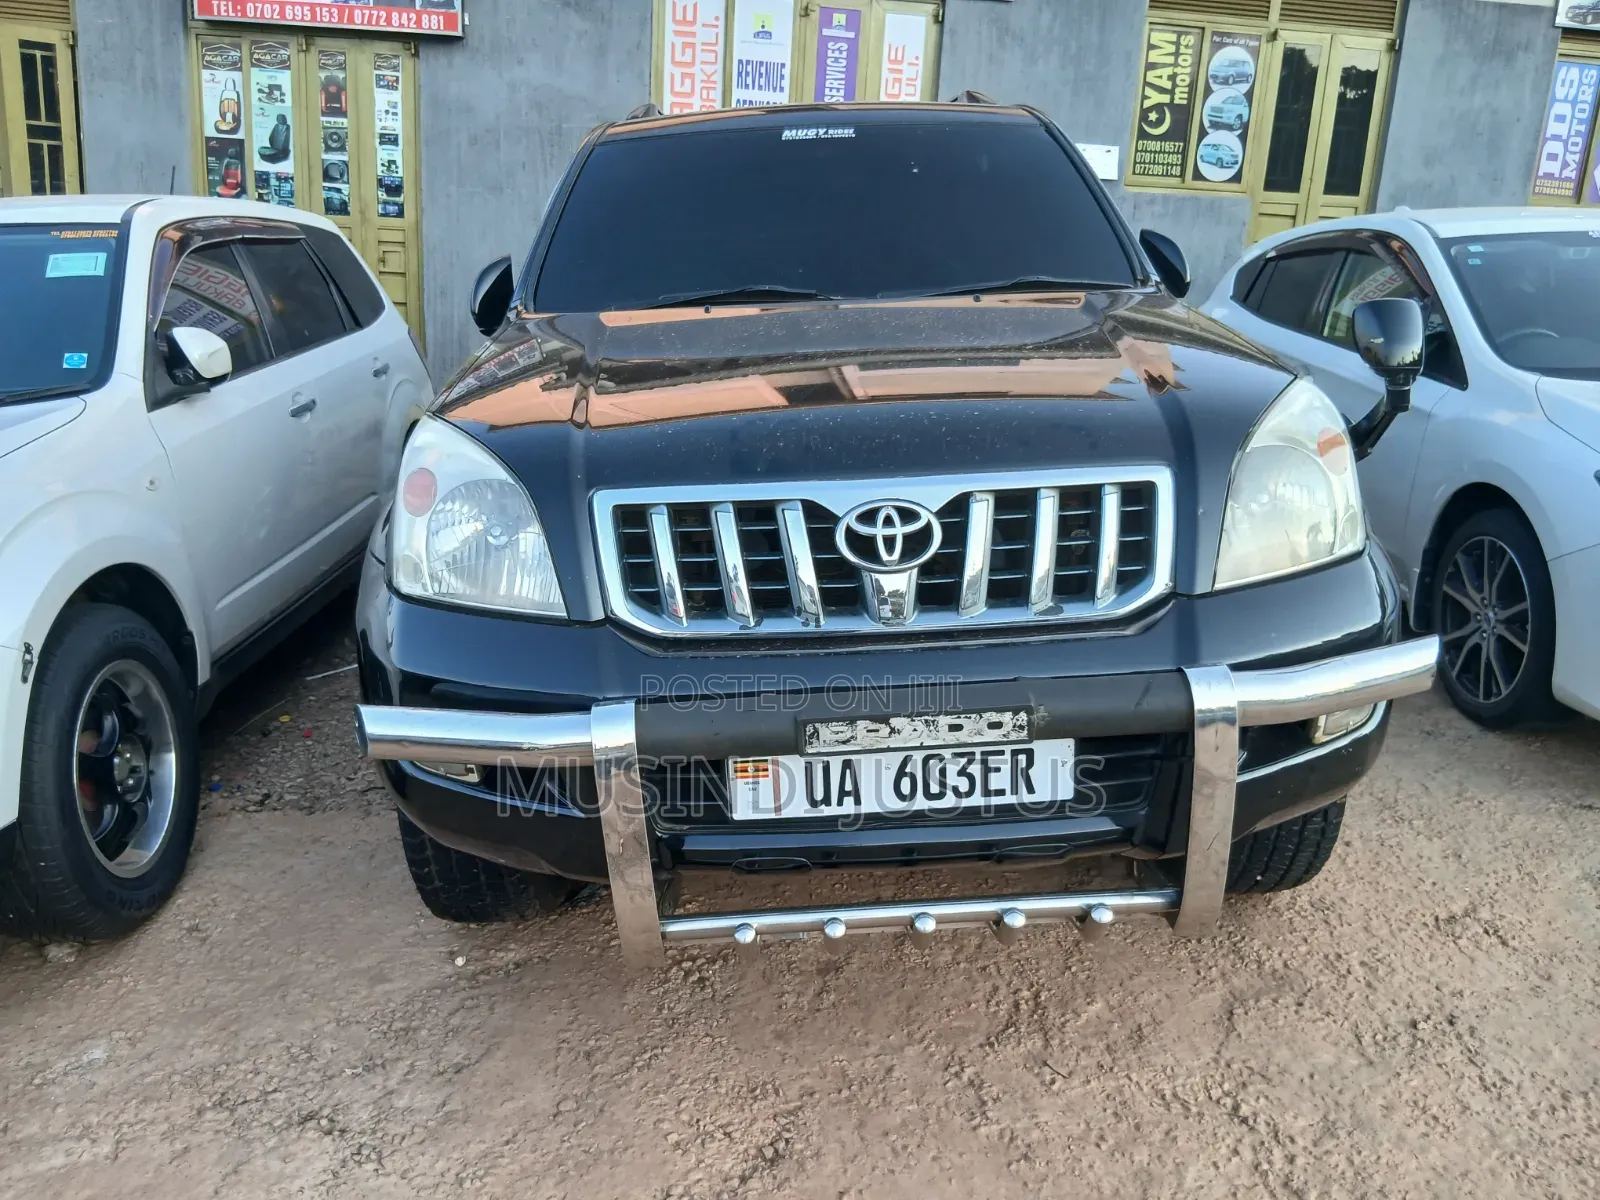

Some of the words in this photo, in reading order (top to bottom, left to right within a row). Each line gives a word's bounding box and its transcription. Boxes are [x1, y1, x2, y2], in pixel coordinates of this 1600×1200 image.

[211, 1, 241, 17] TEL:
[246, 2, 280, 19] 0702
[285, 5, 311, 21] 695
[315, 6, 339, 23] 153
[344, 8, 349, 24] /
[354, 9, 387, 26] 0772
[391, 12, 417, 28] 842
[421, 14, 444, 30] 881
[736, 59, 786, 93] REVENUE
[823, 42, 848, 103] SERVICES
[1143, 32, 1178, 109] YAM
[1173, 34, 1195, 105] motors
[1538, 66, 1580, 178] DDS
[1561, 69, 1597, 180] MOTORS
[804, 758, 862, 808] UA
[893, 747, 1036, 802] 603ER
